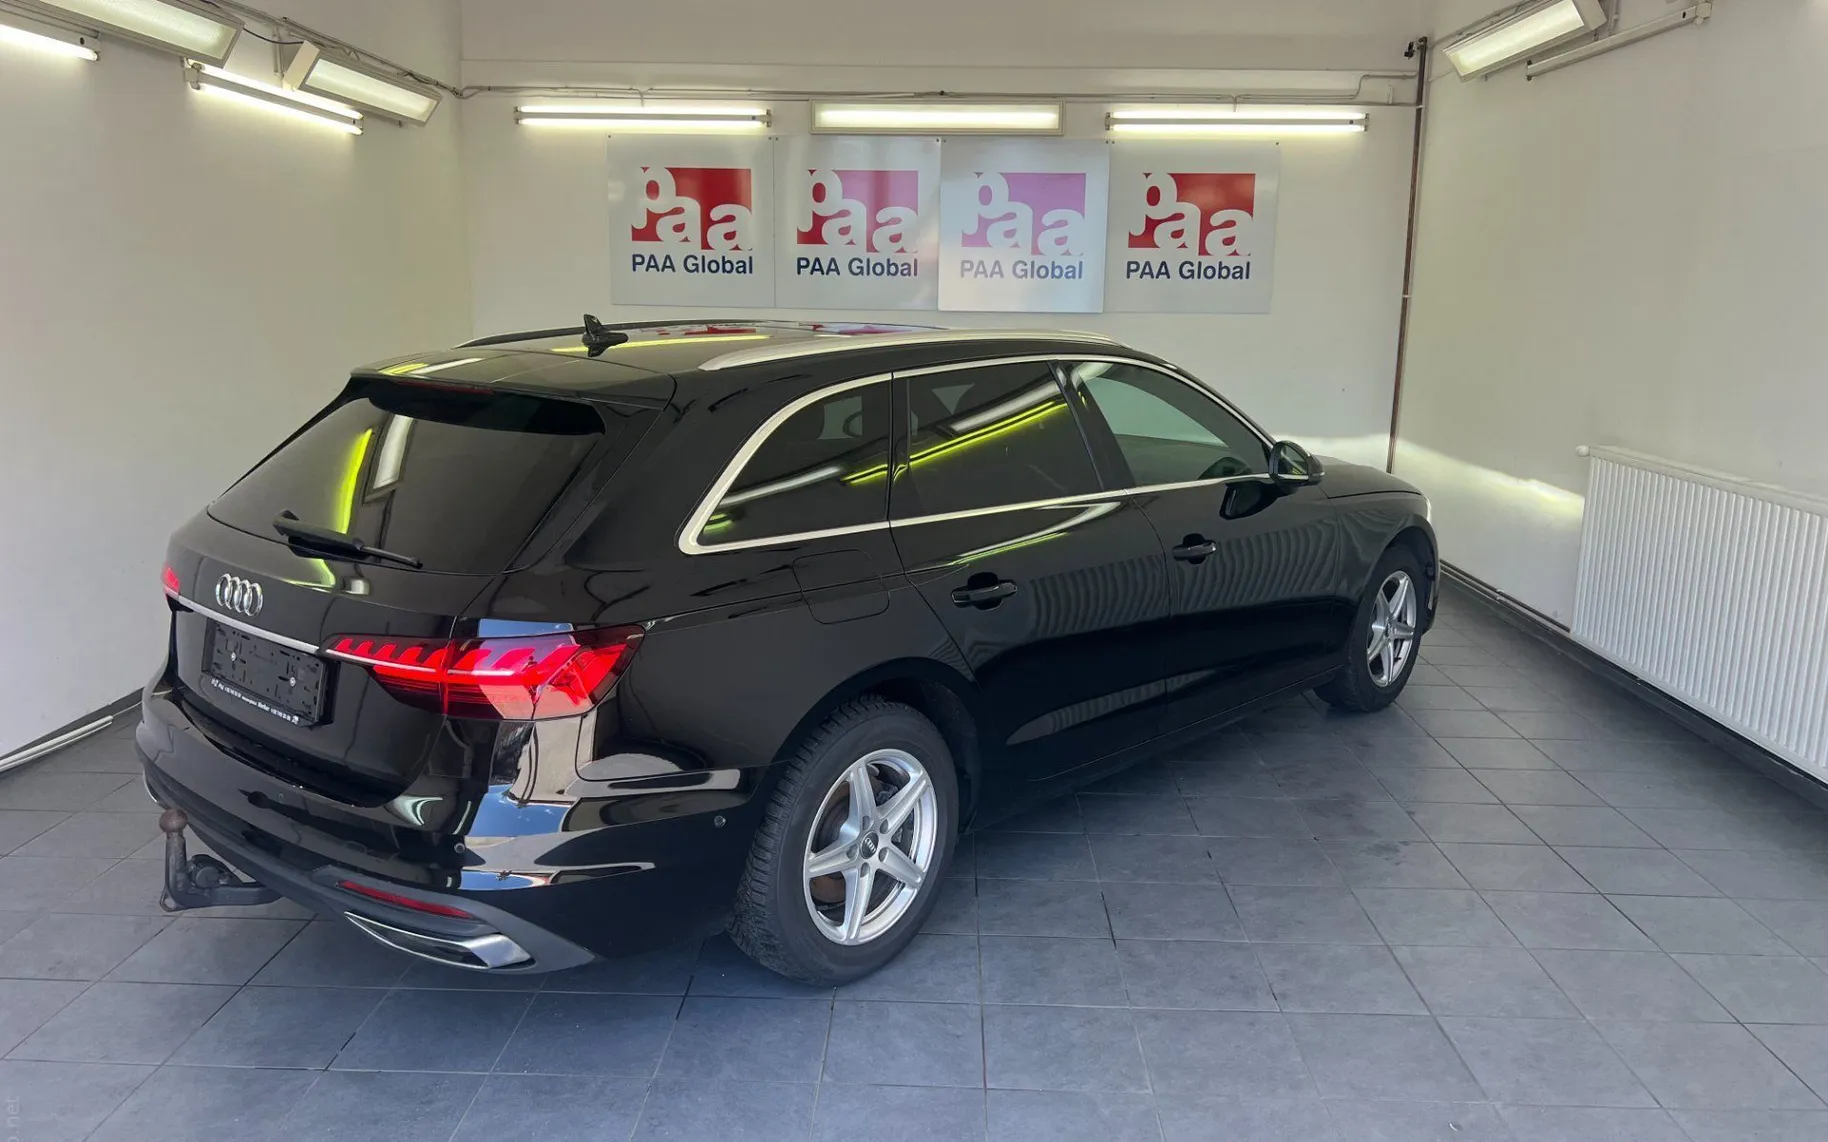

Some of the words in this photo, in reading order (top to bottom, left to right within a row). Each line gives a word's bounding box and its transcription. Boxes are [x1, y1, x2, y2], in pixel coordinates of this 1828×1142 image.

[631, 254, 676, 273] PAA
[683, 255, 753, 275] Global
[796, 257, 840, 275] PAA
[847, 257, 918, 277] Global
[960, 260, 1004, 278] PAA
[1012, 260, 1083, 280] Global
[1126, 260, 1170, 279] PAA
[1178, 260, 1250, 280] Global
